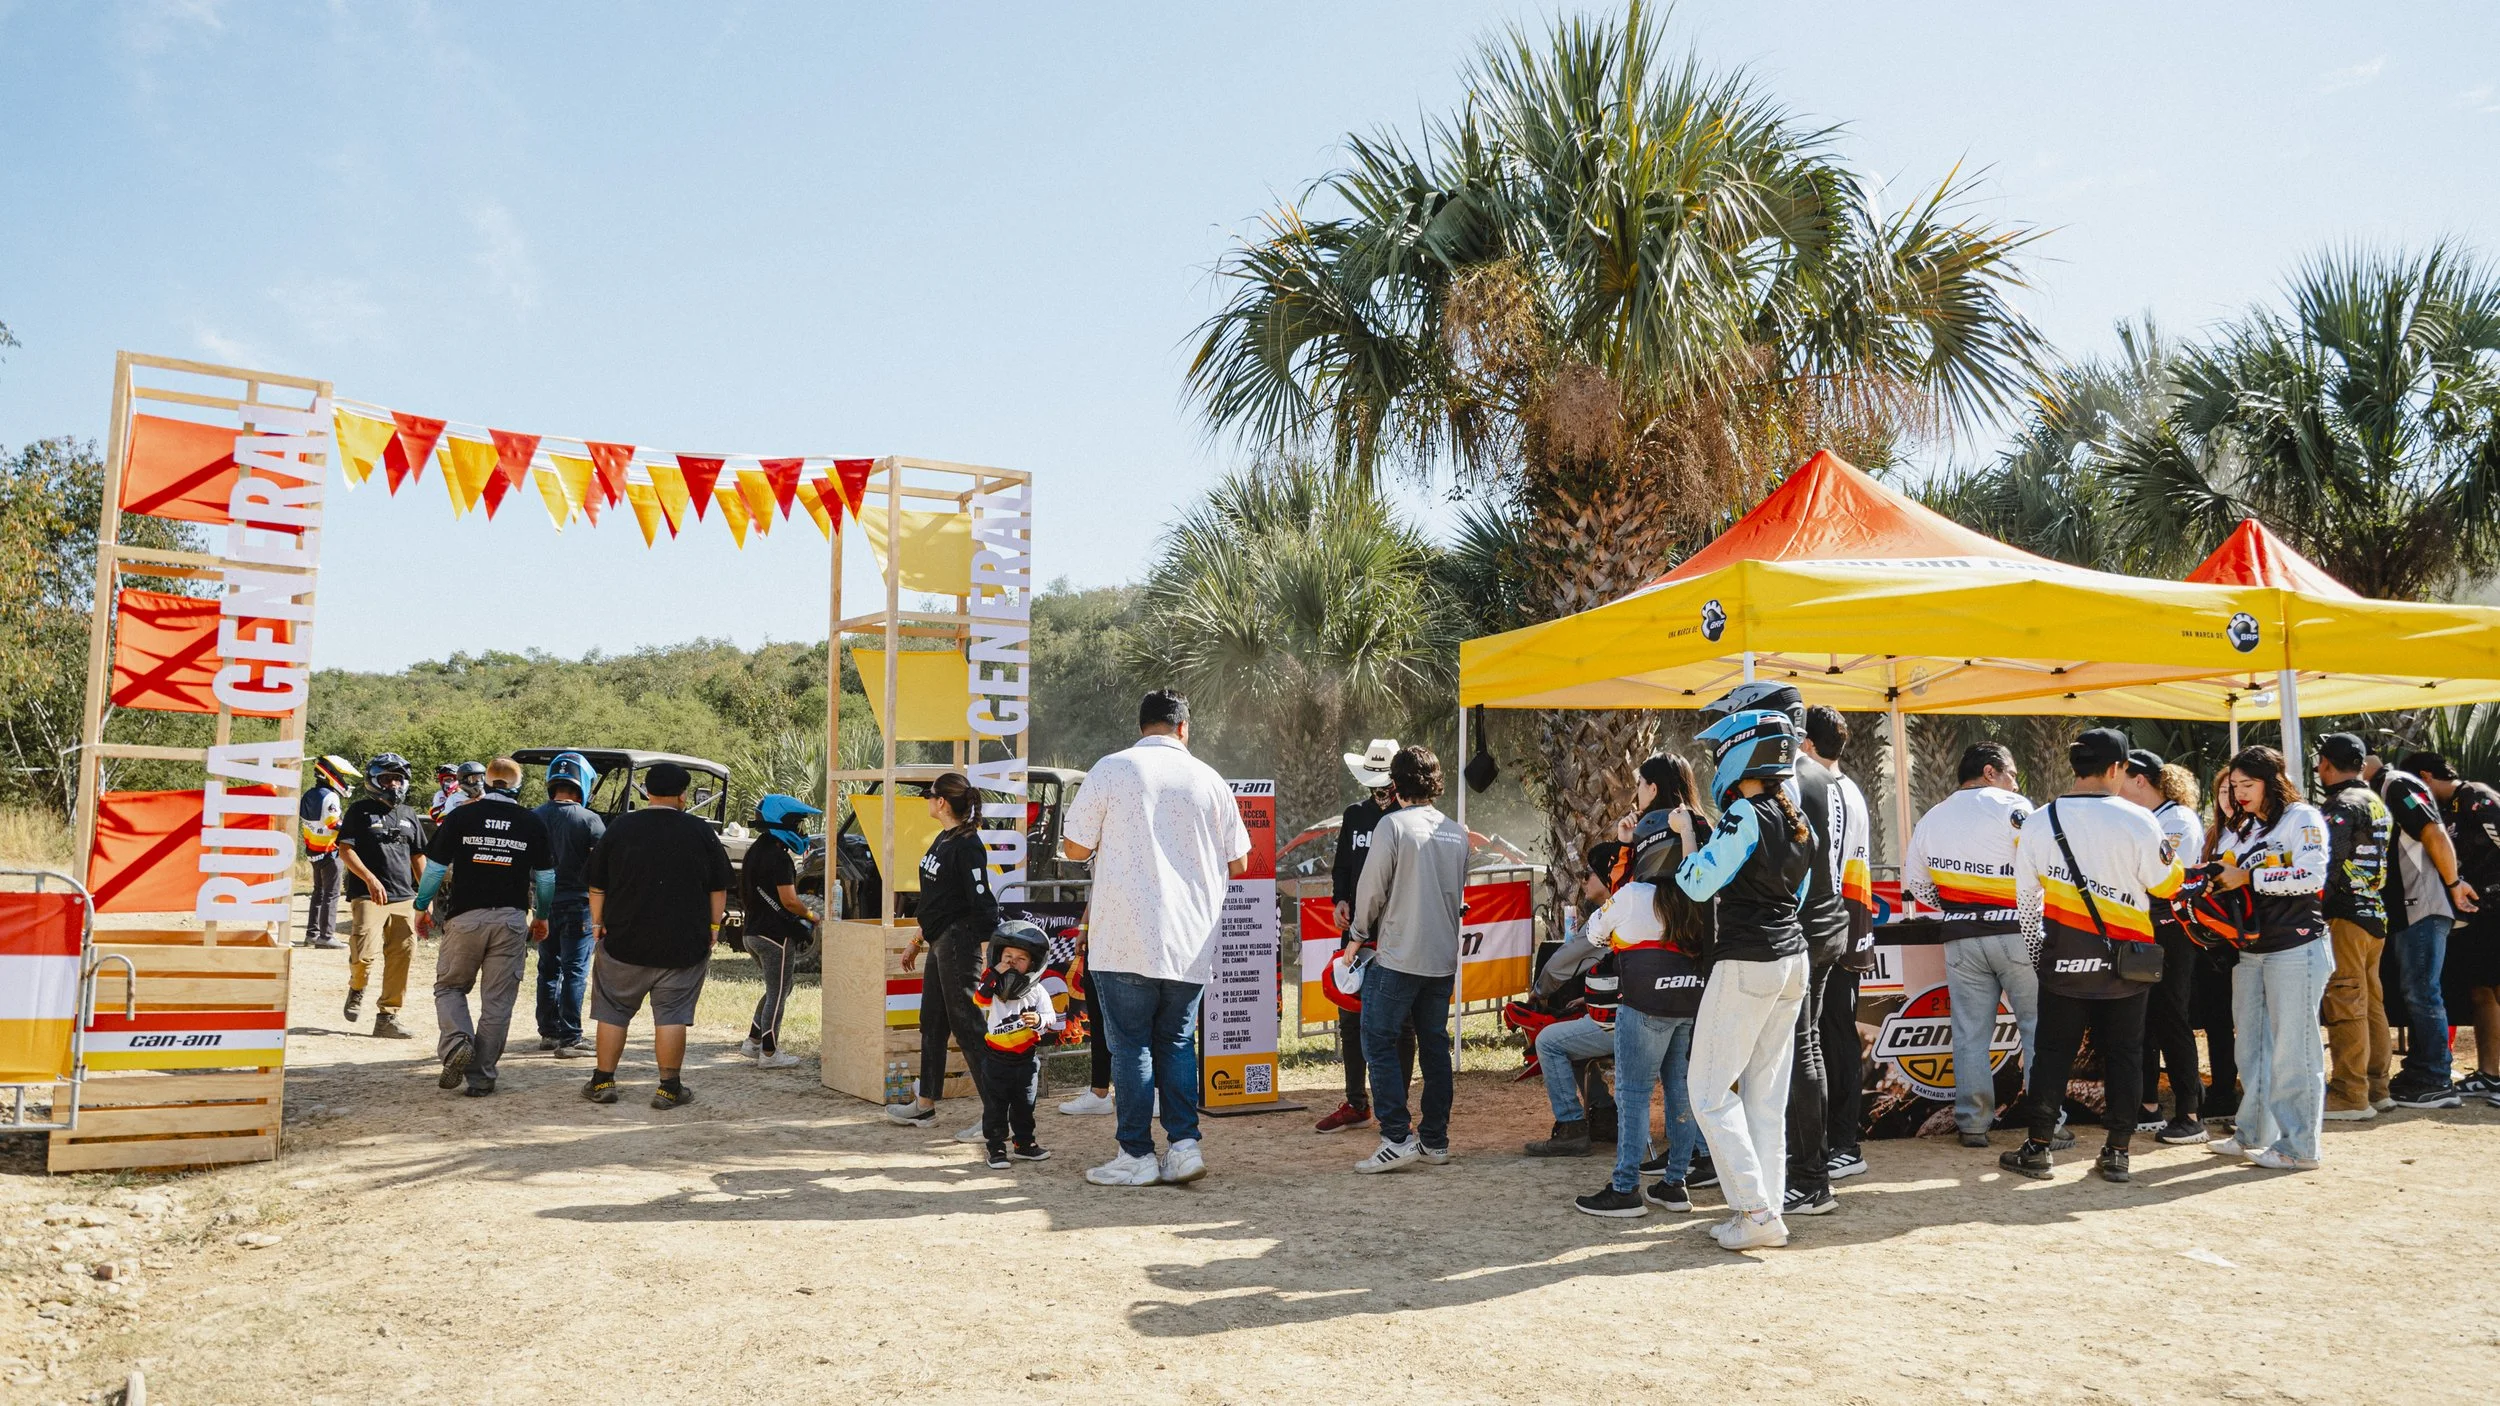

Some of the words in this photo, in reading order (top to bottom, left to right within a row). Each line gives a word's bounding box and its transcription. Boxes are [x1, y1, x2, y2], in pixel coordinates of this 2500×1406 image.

[213, 398, 333, 712] GENERAL
[967, 483, 1032, 736] GENERAL
[2195, 630, 2214, 638] MARCA
[2240, 633, 2258, 641] BRP
[1716, 729, 1756, 758] can-am
[1229, 782, 1272, 793] n-am
[197, 739, 304, 922] RUTA
[485, 819, 511, 831] STAFF
[462, 836, 484, 846] RUTAS
[496, 838, 528, 851] TERRENO
[1352, 830, 1373, 851] jel
[1636, 830, 1668, 853] can-am
[2303, 828, 2322, 844] 15
[473, 853, 512, 863] can-am
[1927, 856, 1961, 871] GRUPO
[1964, 861, 1994, 875] RISE
[1228, 884, 1245, 893] ENTO:
[2047, 865, 2088, 888] GRUO
[2088, 881, 2118, 899] RISE
[1021, 910, 1049, 931] BORN
[2054, 957, 2112, 973] can-
[1654, 974, 1705, 991] can-
[129, 1034, 222, 1048] can-am
[1914, 1085, 1946, 1099] SANTIAGO,
